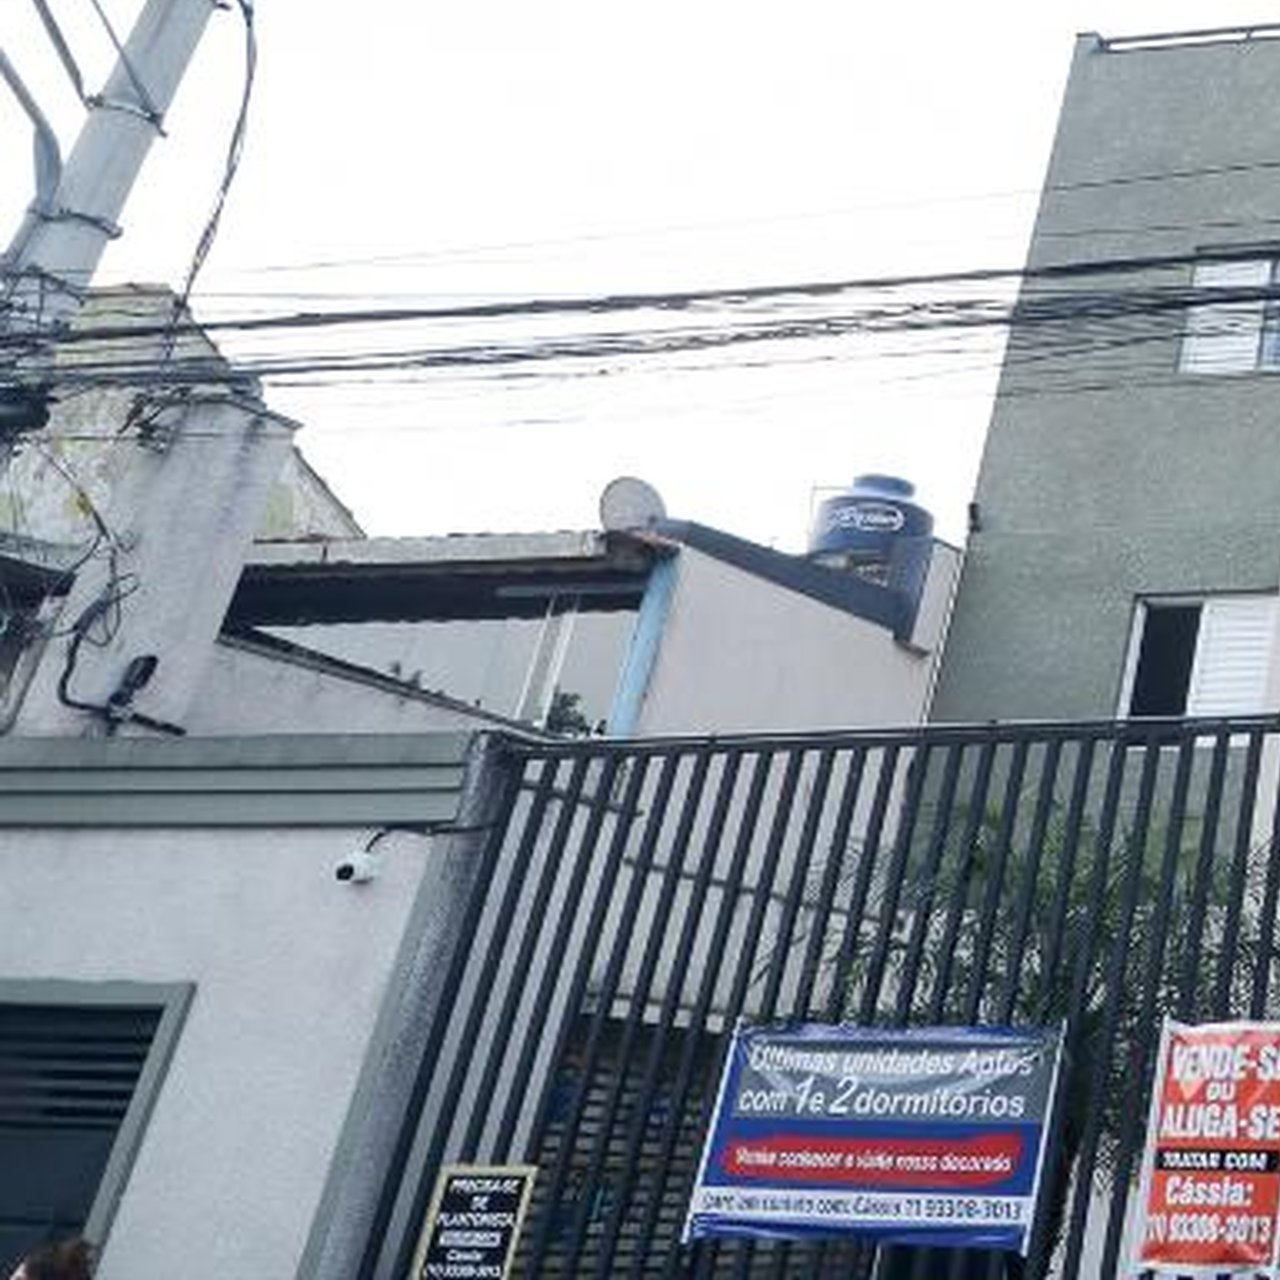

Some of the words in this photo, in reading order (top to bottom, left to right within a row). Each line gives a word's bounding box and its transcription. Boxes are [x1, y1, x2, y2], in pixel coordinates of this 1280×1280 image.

[842, 1048, 955, 1075] unidades
[739, 1089, 789, 1112] com
[796, 1075, 816, 1113] 1
[808, 1091, 825, 1112] e
[829, 1076, 859, 1114] 2
[853, 1087, 1026, 1117] dormitórios
[1206, 1081, 1235, 1101] OU
[1166, 1175, 1254, 1207] Cássia:
